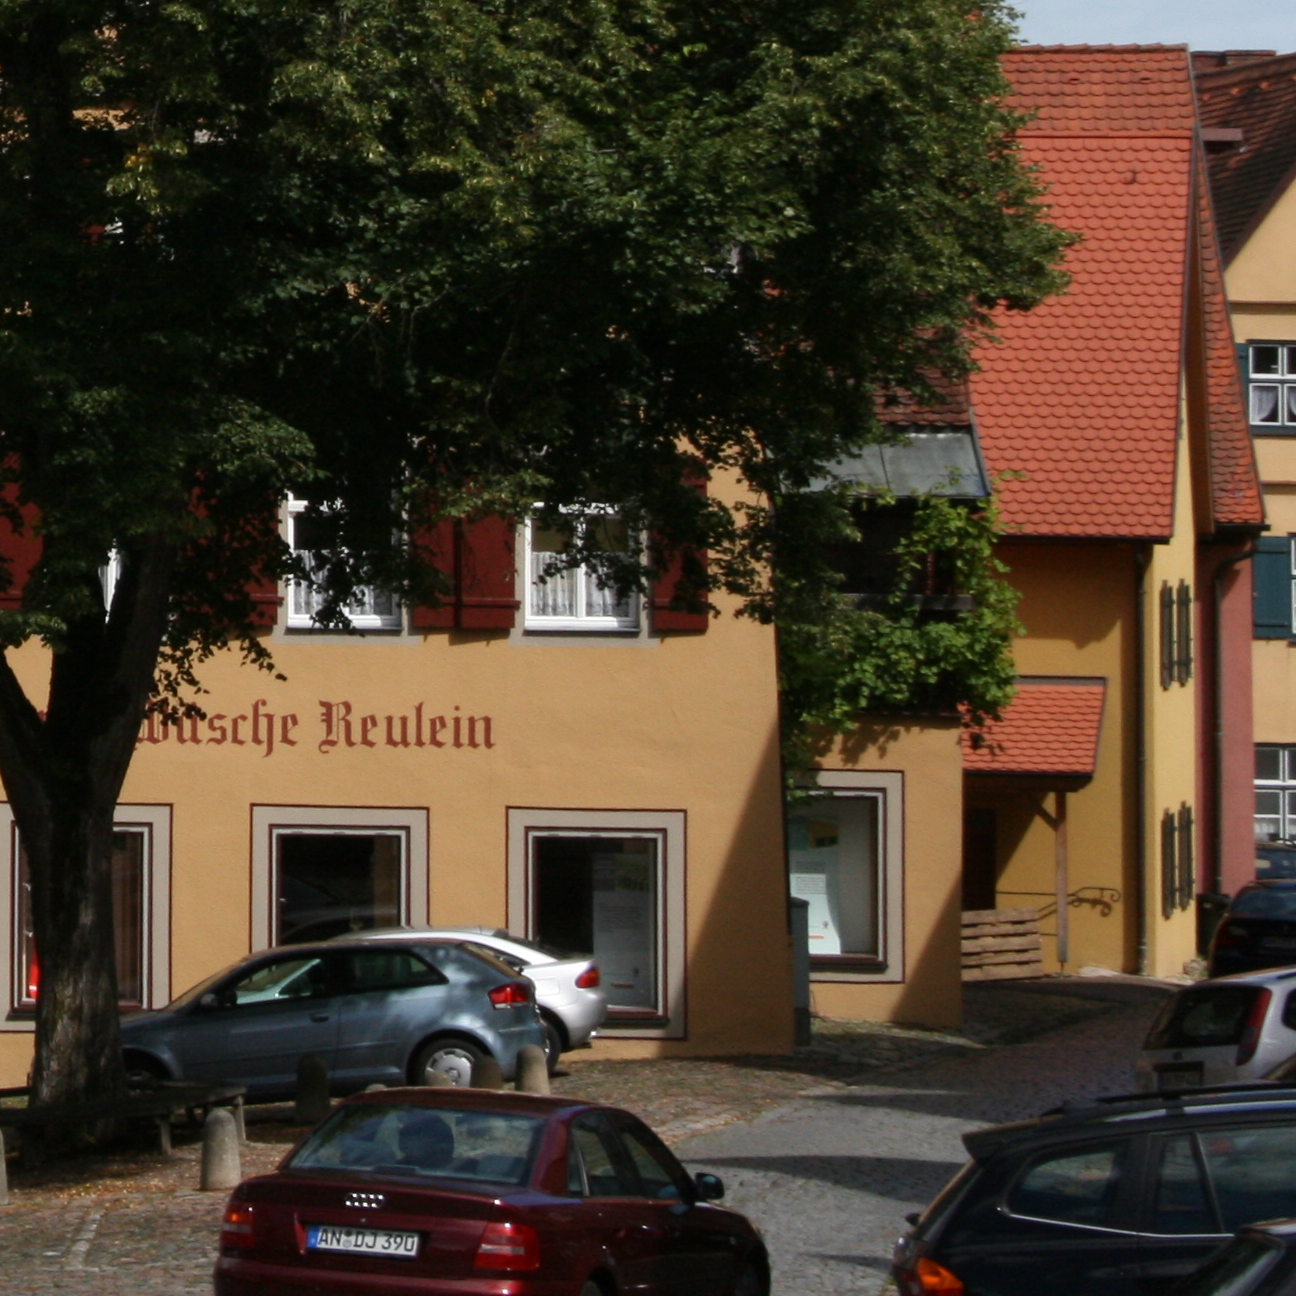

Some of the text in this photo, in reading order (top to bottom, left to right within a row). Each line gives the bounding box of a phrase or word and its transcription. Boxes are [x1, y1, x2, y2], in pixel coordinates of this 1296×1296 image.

[318, 700, 496, 754] Reulein
[318, 1227, 416, 1252] AN DJ 390
